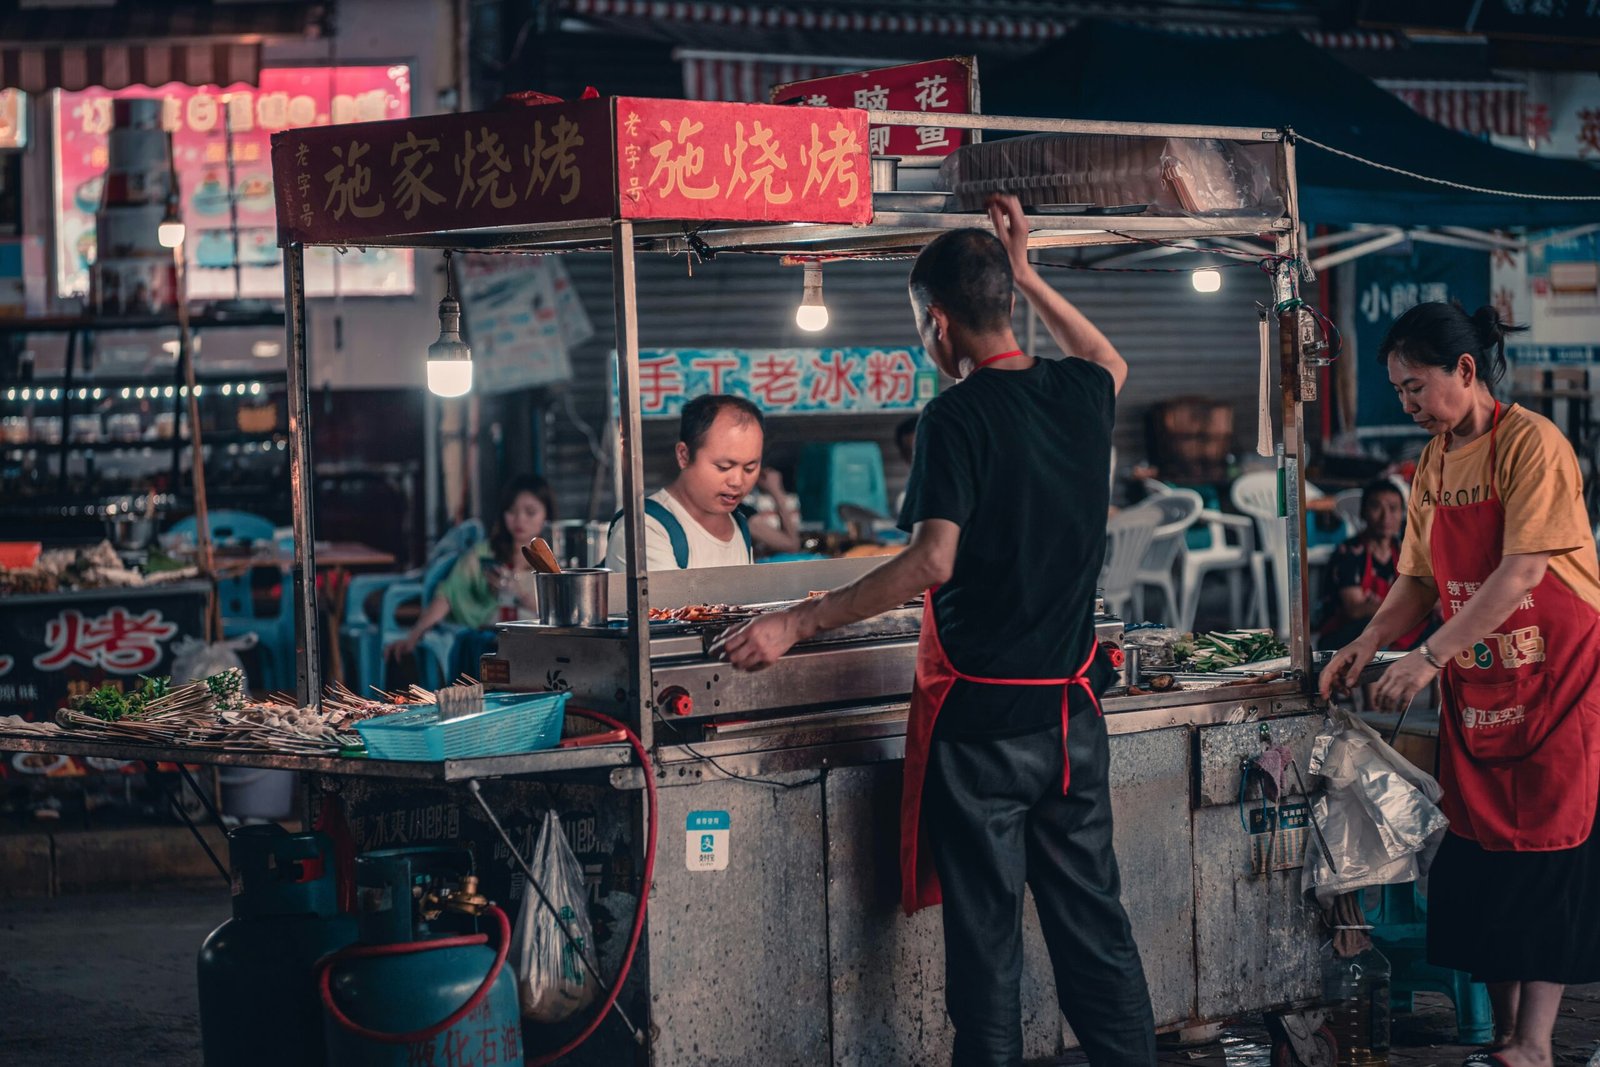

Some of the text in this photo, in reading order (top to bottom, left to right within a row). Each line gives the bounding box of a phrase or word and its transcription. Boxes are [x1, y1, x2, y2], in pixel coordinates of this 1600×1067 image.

[295, 142, 315, 228] 老字号
[324, 114, 584, 221] 施家烧烤
[624, 111, 644, 202] 老字号
[649, 117, 862, 207] 施烧烤
[0, 606, 178, 676] 烤
